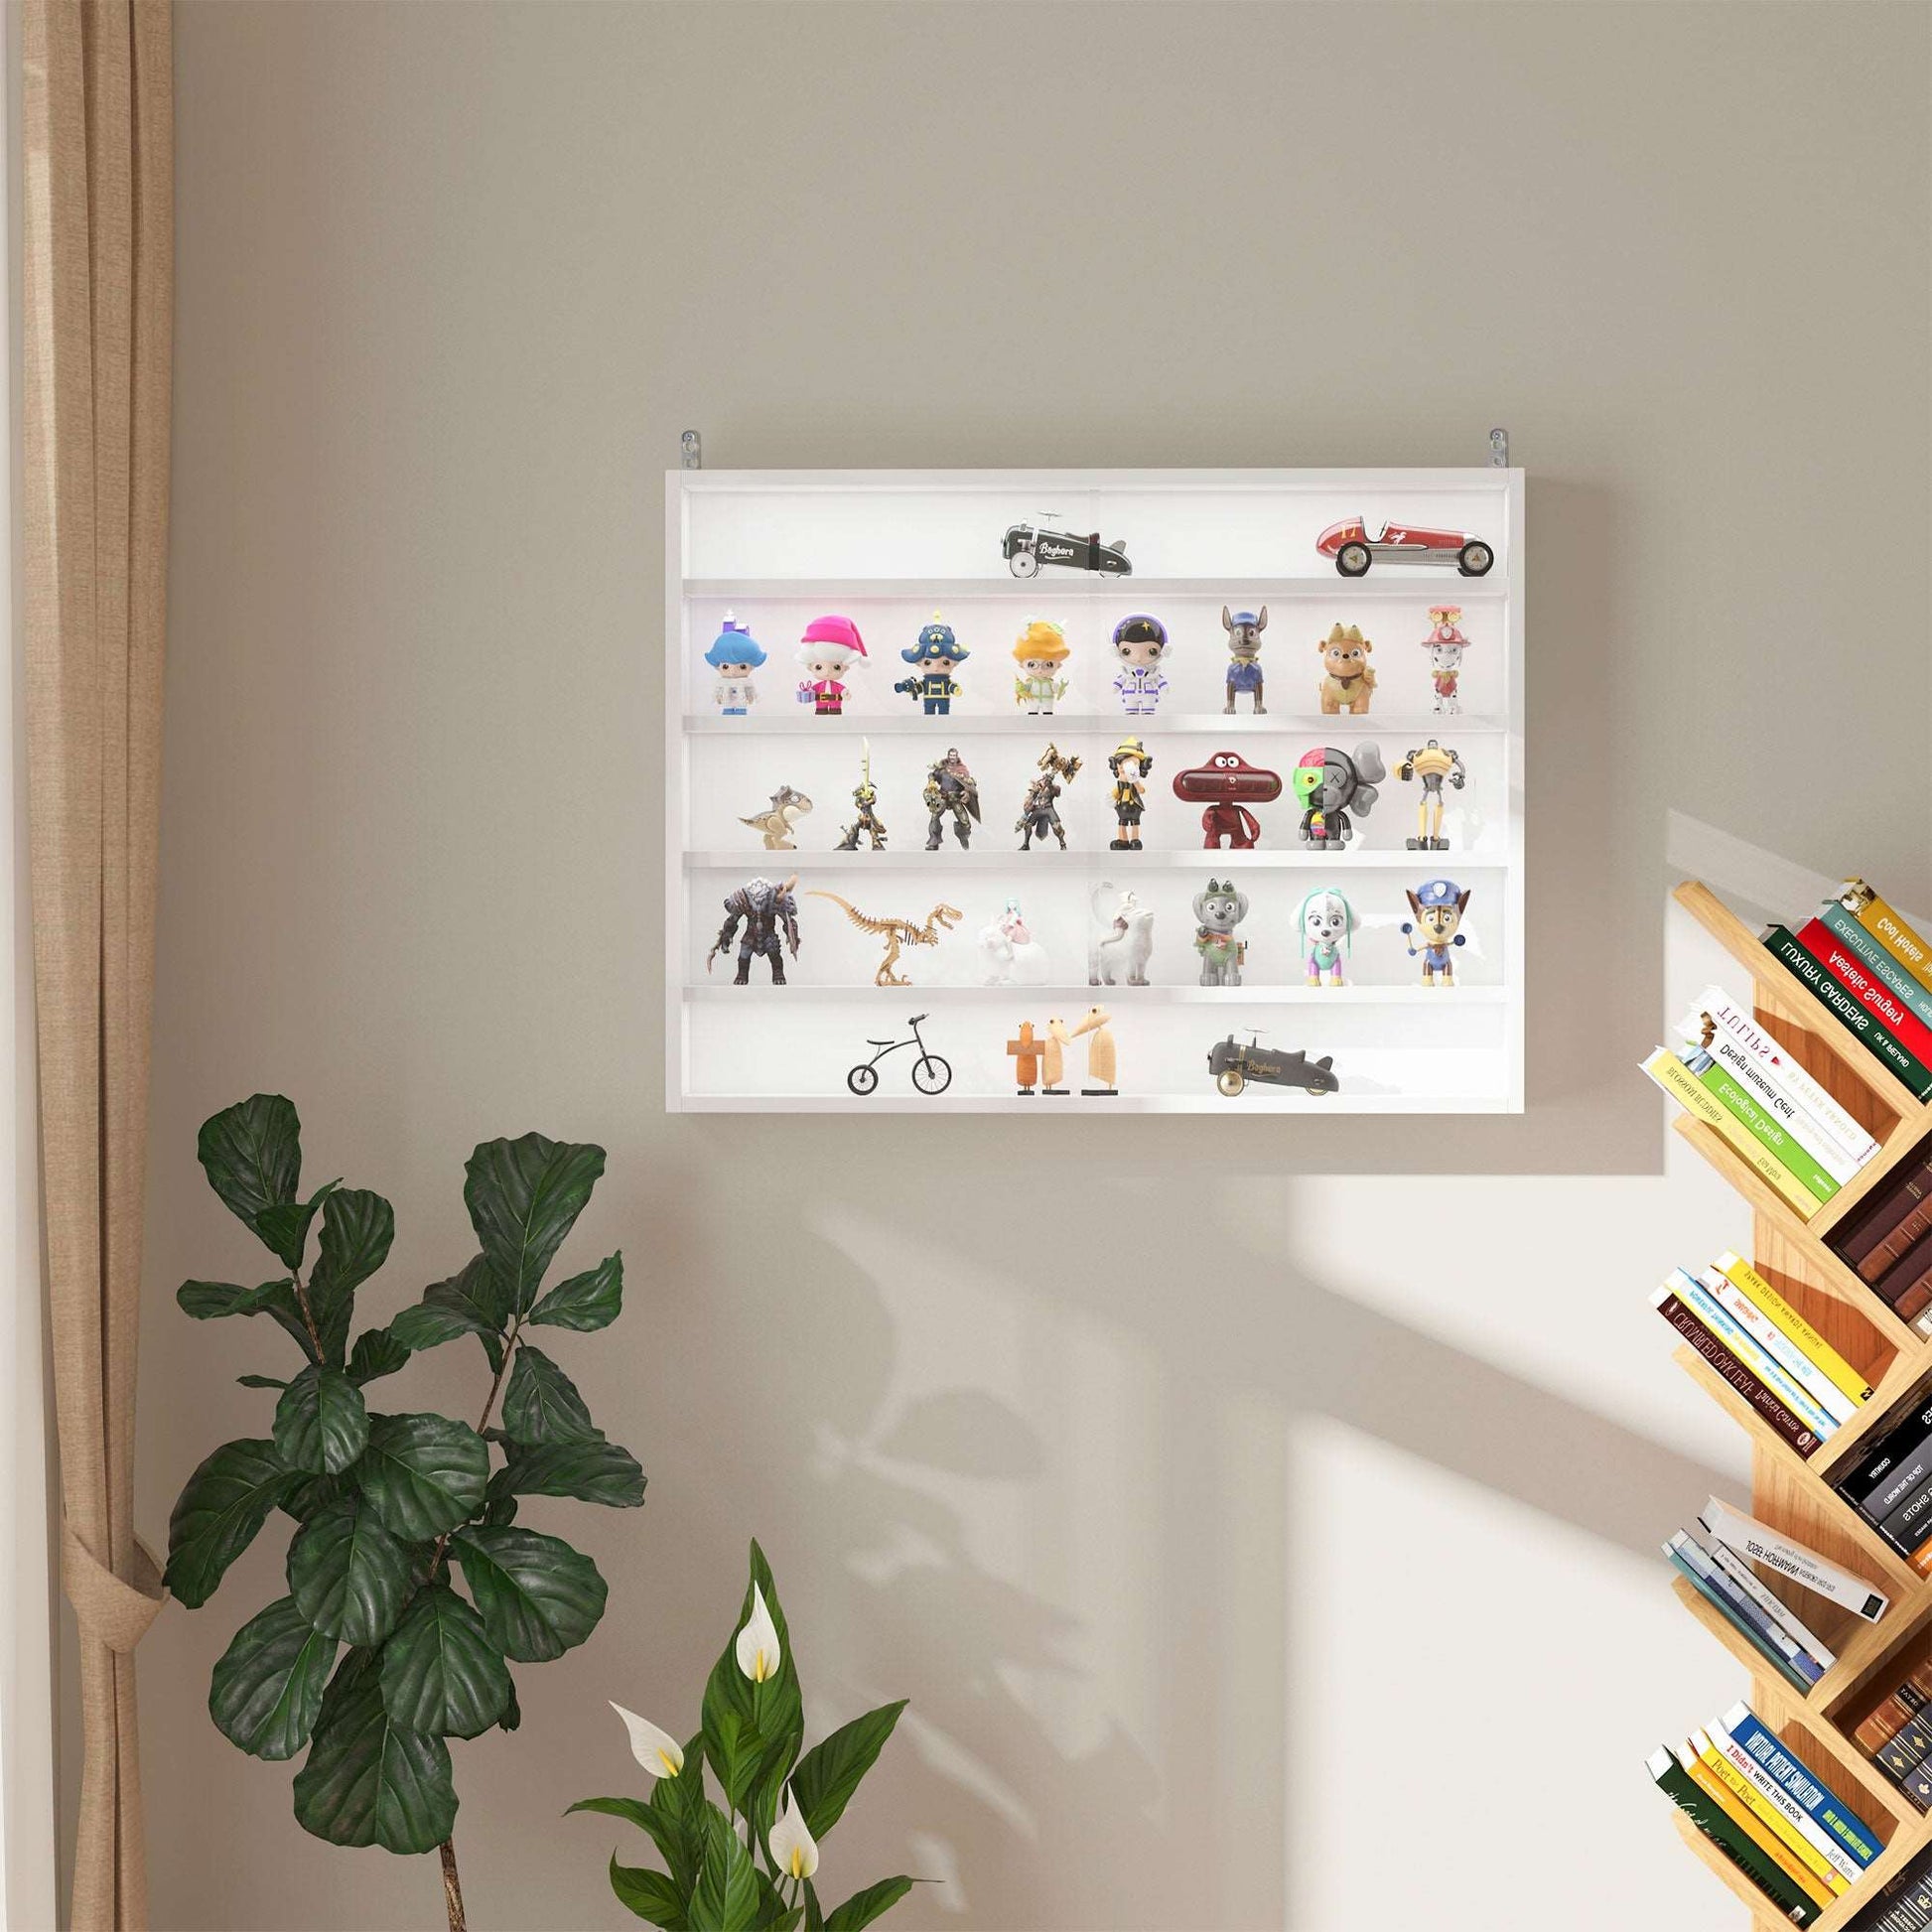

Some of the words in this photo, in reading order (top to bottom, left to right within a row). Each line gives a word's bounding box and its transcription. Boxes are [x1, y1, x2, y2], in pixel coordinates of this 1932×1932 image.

[1340, 525, 1358, 539] 17
[1725, 1743, 1734, 1752] I
[1729, 1747, 1756, 1774] Didn't
[1742, 1729, 1777, 1764] VIRTUAL
[1763, 1750, 1797, 1784] PATIENT
[1782, 1769, 1825, 1812] SIMULATION
[1710, 1757, 1732, 1780] Poet
[1735, 1783, 1758, 1806] Poet
[1751, 1769, 1773, 1792] WRITE
[1769, 1787, 1787, 1806] THIS
[1782, 1801, 1804, 1823] BOOK
